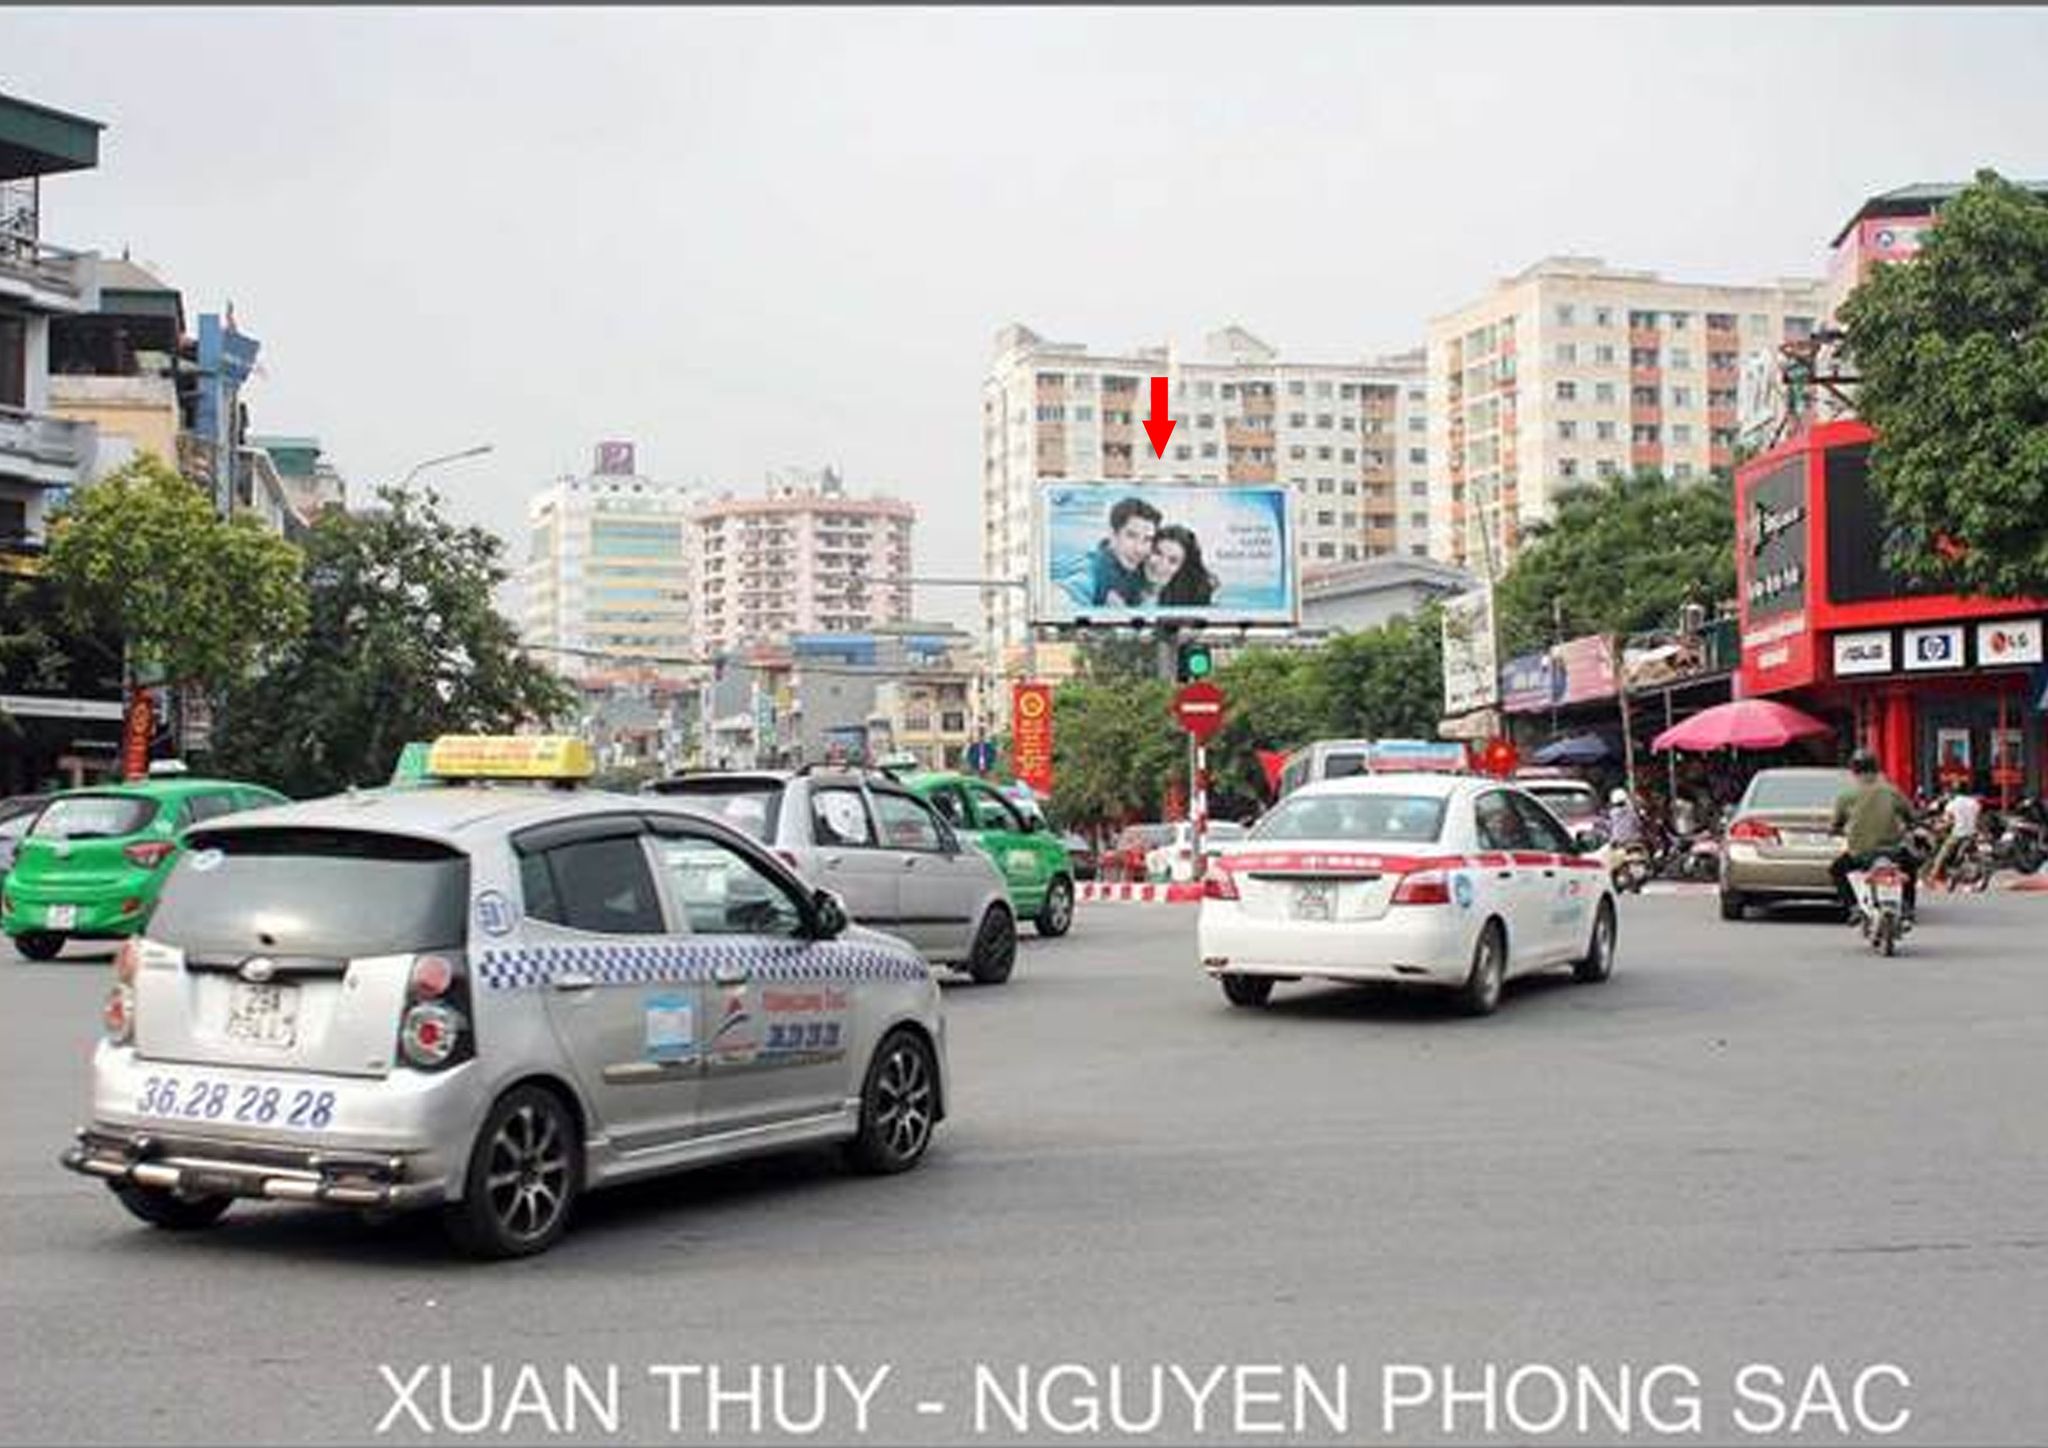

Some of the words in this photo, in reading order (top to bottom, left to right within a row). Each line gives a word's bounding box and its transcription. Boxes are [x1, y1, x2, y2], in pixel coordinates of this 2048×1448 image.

[2008, 630, 2029, 649] LG
[136, 1075, 229, 1119] 36.28
[234, 1085, 281, 1123] 28
[287, 1089, 336, 1128] 28
